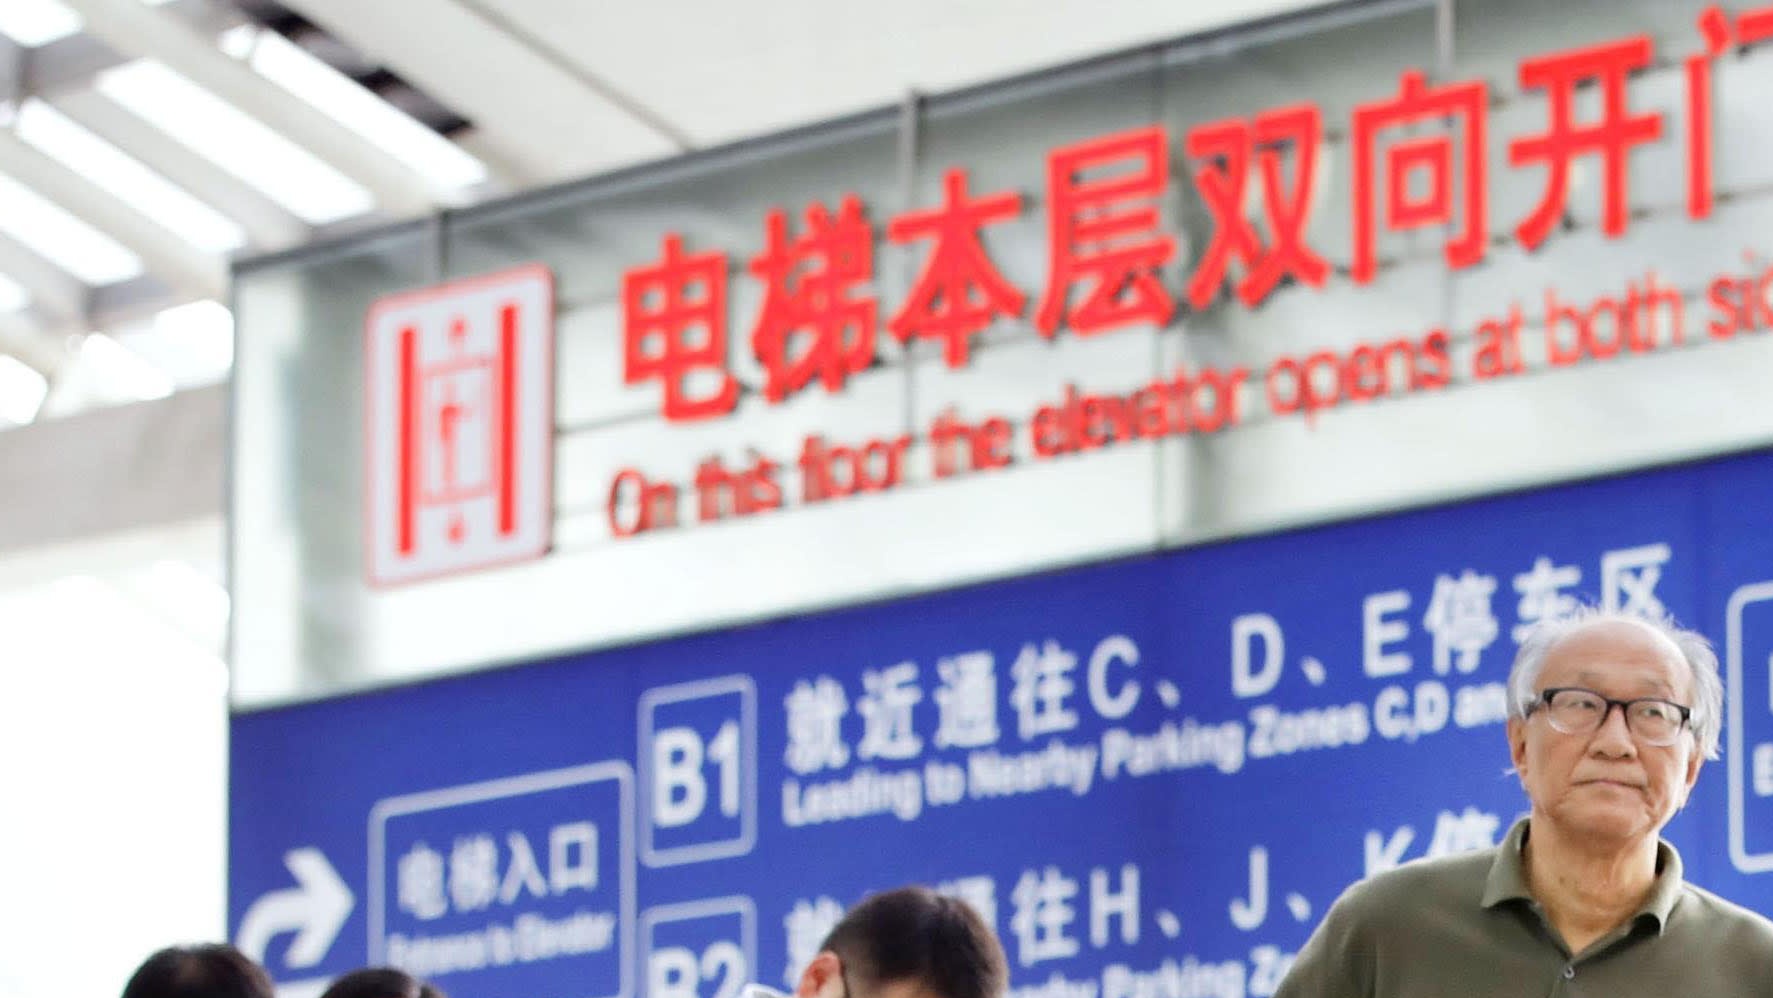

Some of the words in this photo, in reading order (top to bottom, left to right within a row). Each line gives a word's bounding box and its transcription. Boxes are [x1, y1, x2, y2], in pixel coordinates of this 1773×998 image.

[608, 466, 678, 538] On
[694, 447, 783, 522] this
[799, 432, 912, 503] floor
[928, 404, 1013, 479] the
[1031, 365, 1248, 458] elevator
[1266, 327, 1451, 430] opens
[1472, 300, 1526, 380] at
[1544, 269, 1686, 368] both
[654, 718, 741, 830] B1
[781, 765, 923, 828] Leading
[924, 756, 967, 807] to
[967, 739, 1099, 800] Nearby
[1101, 716, 1246, 780] Parking
[1248, 701, 1371, 760] Zones
[1453, 680, 1508, 729] an
[397, 820, 599, 921] 电梯入口
